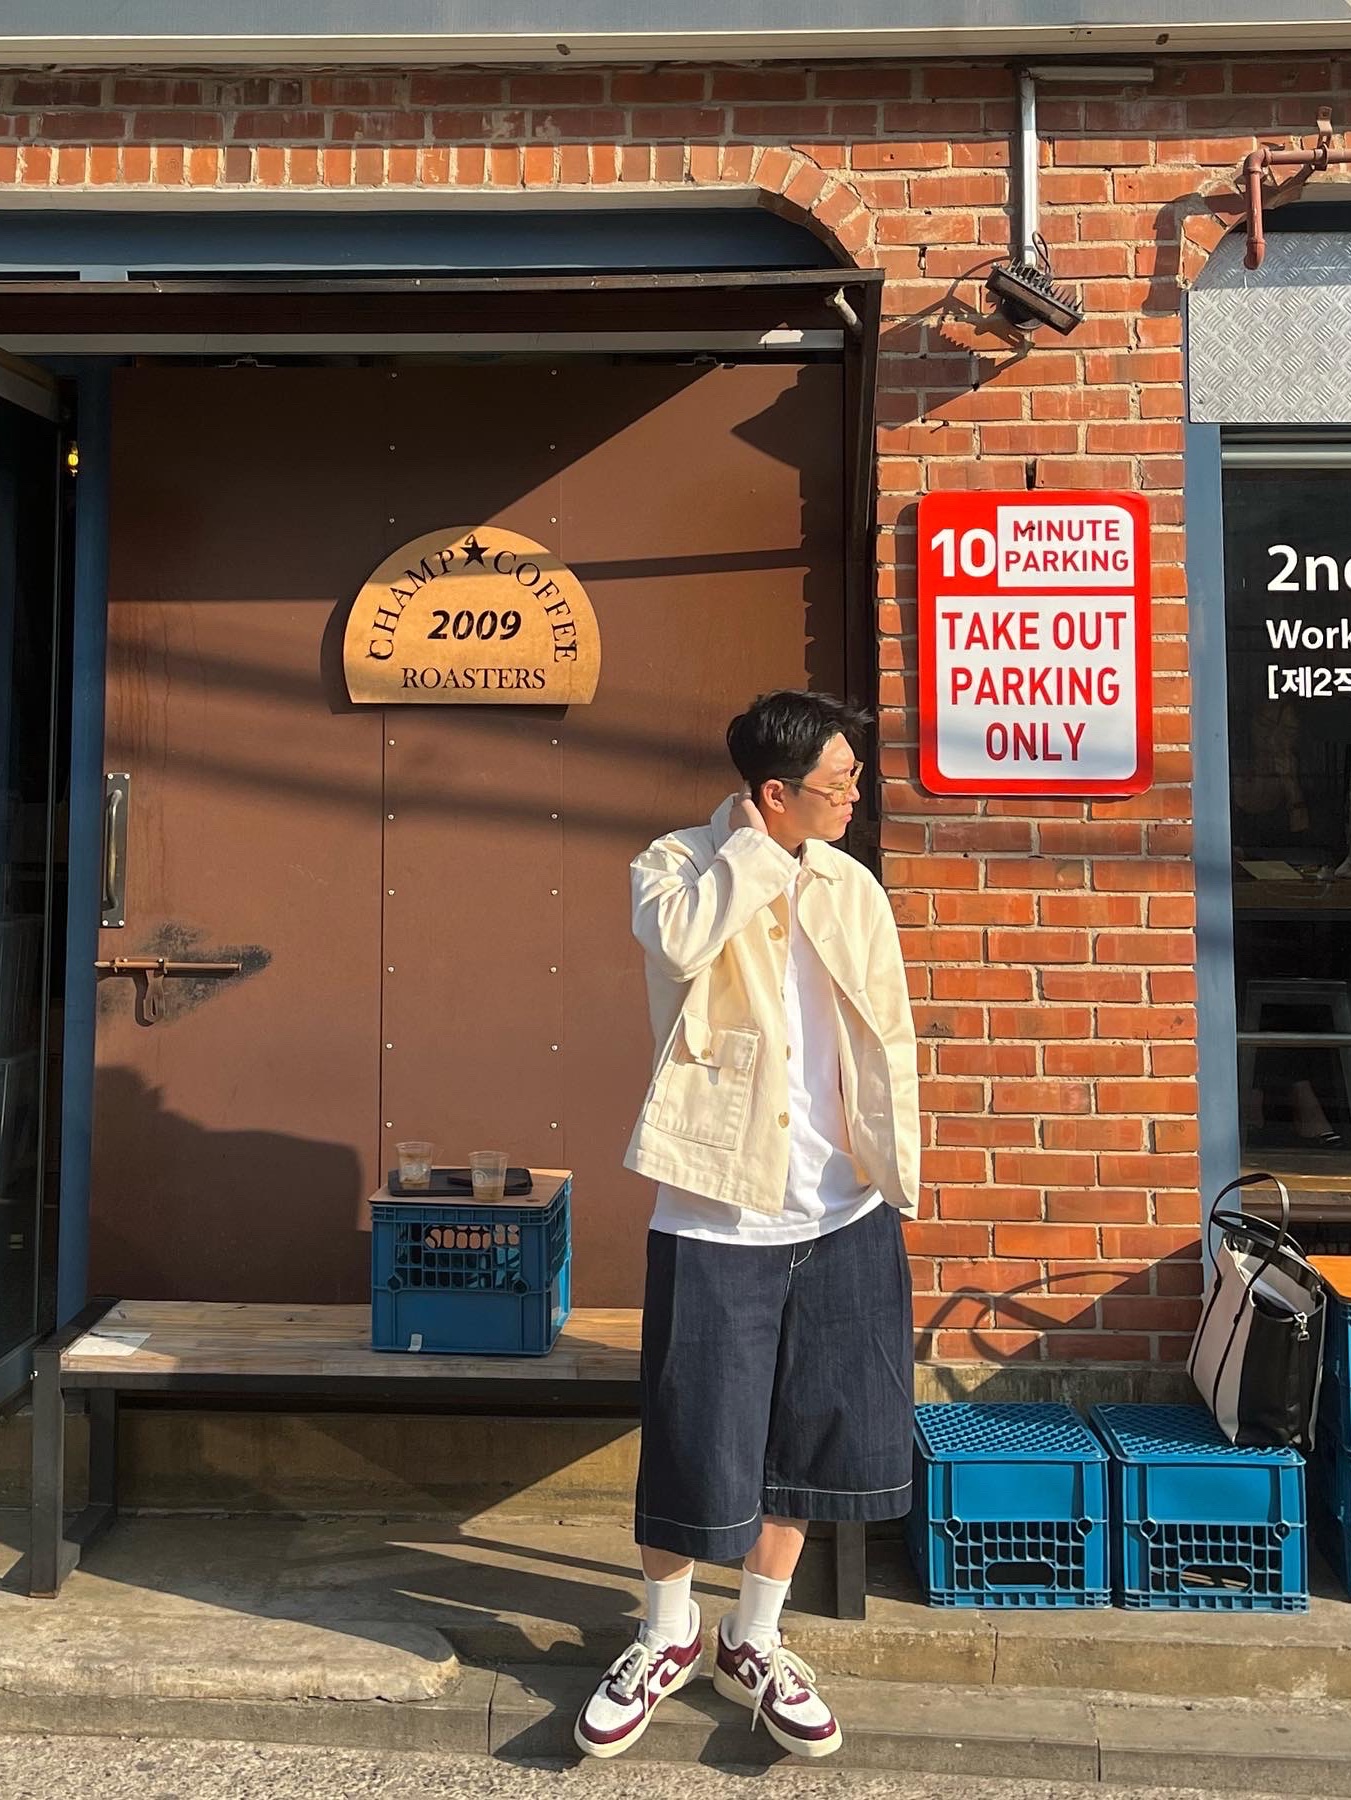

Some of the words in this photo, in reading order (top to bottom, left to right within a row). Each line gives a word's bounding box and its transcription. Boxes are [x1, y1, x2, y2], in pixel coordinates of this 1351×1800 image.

[1013, 519, 1120, 542] MINUTE
[931, 528, 996, 578] 10
[1005, 550, 1129, 572] PARKING
[1267, 544, 1351, 591] 2n
[367, 549, 455, 661] CHAMP
[493, 550, 577, 663] COFFEE
[427, 609, 522, 641] 2009
[942, 612, 1040, 650] TAKE
[1052, 612, 1127, 650] OUT
[401, 667, 545, 690] ROASTERS
[951, 667, 1120, 705] PARKING
[986, 723, 1086, 761] ONLY
